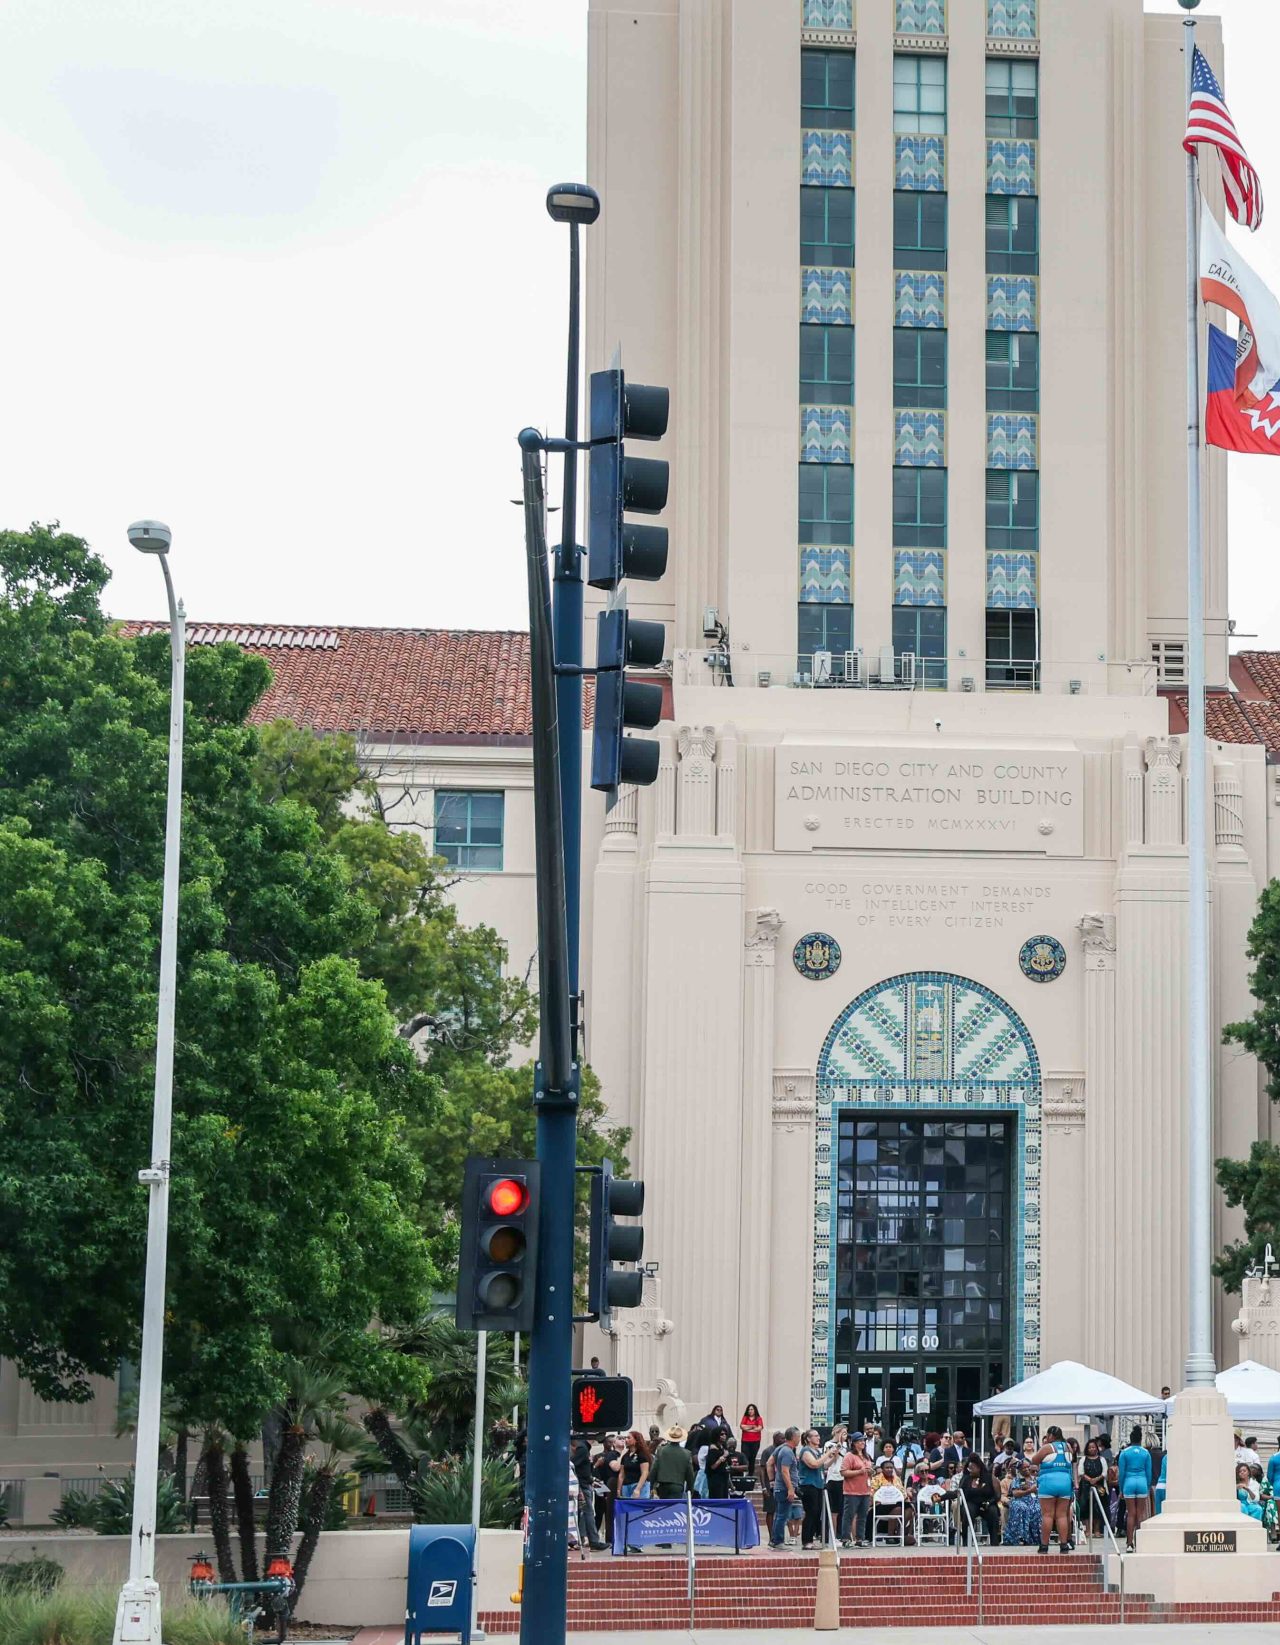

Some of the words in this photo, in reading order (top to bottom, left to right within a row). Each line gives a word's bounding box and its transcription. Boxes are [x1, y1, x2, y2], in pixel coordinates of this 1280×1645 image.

[790, 761, 823, 775] SAN
[835, 762, 890, 777] DIEGO
[899, 763, 938, 777] CITY
[947, 765, 984, 778] AND
[993, 765, 1068, 780] COUNTY
[786, 785, 961, 804] ADMINISTRATION
[976, 789, 1072, 806] BUILDING
[843, 817, 915, 829] ERECTED
[927, 819, 1016, 832] MCMXXXVI
[805, 883, 848, 894] GOOD
[862, 884, 968, 897] GOVERNMENT
[983, 886, 1051, 898] DEMANDS
[825, 899, 851, 910] THE
[865, 900, 956, 911] INTELLIGENT
[971, 901, 1034, 912] INTEREST
[857, 915, 876, 926] OF
[889, 916, 931, 927] EVERY
[945, 917, 1004, 927] CITIZEN
[1196, 1532, 1225, 1544] 1600
